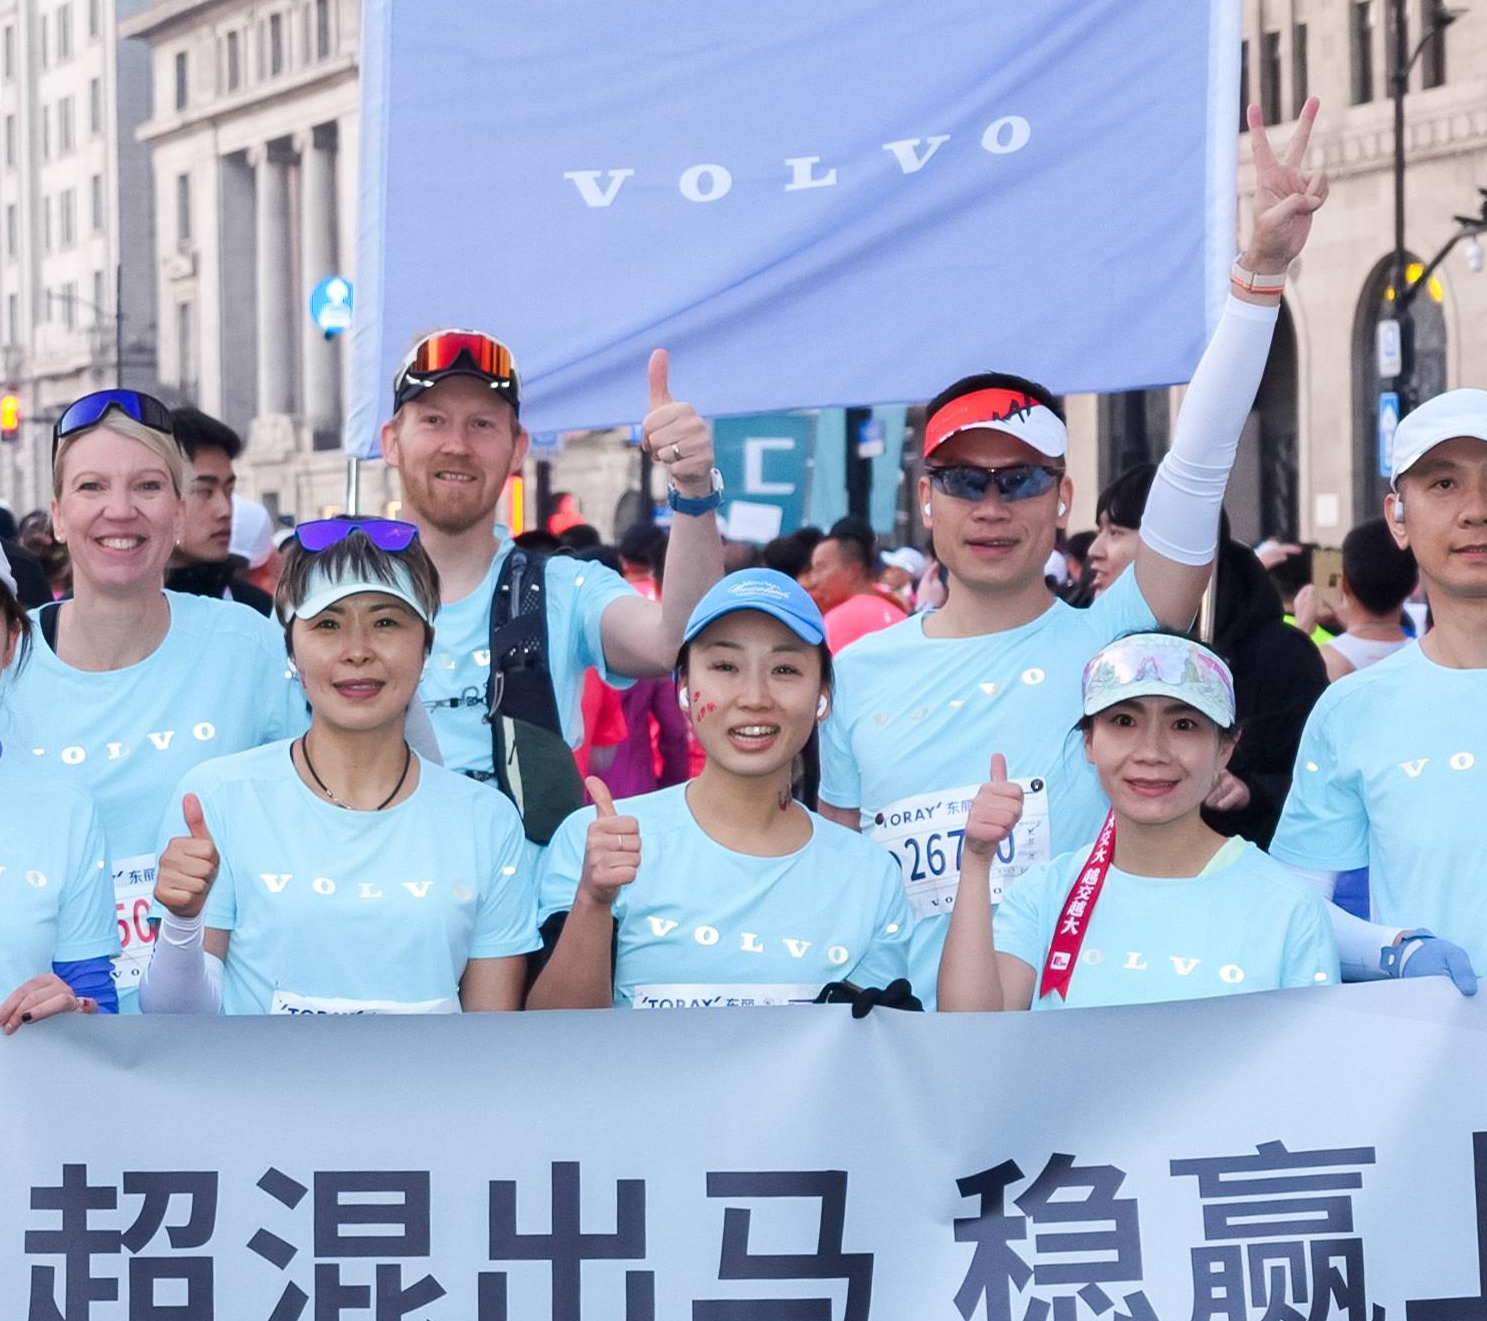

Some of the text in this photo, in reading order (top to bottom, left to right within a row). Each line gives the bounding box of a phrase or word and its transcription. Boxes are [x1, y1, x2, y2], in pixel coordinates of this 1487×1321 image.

[563, 113, 1031, 208] VOLVO
[32, 722, 215, 765] OLVO
[260, 873, 473, 902] VOLVO
[647, 916, 849, 965] VOLVO
[1081, 949, 1245, 984] OLVO
